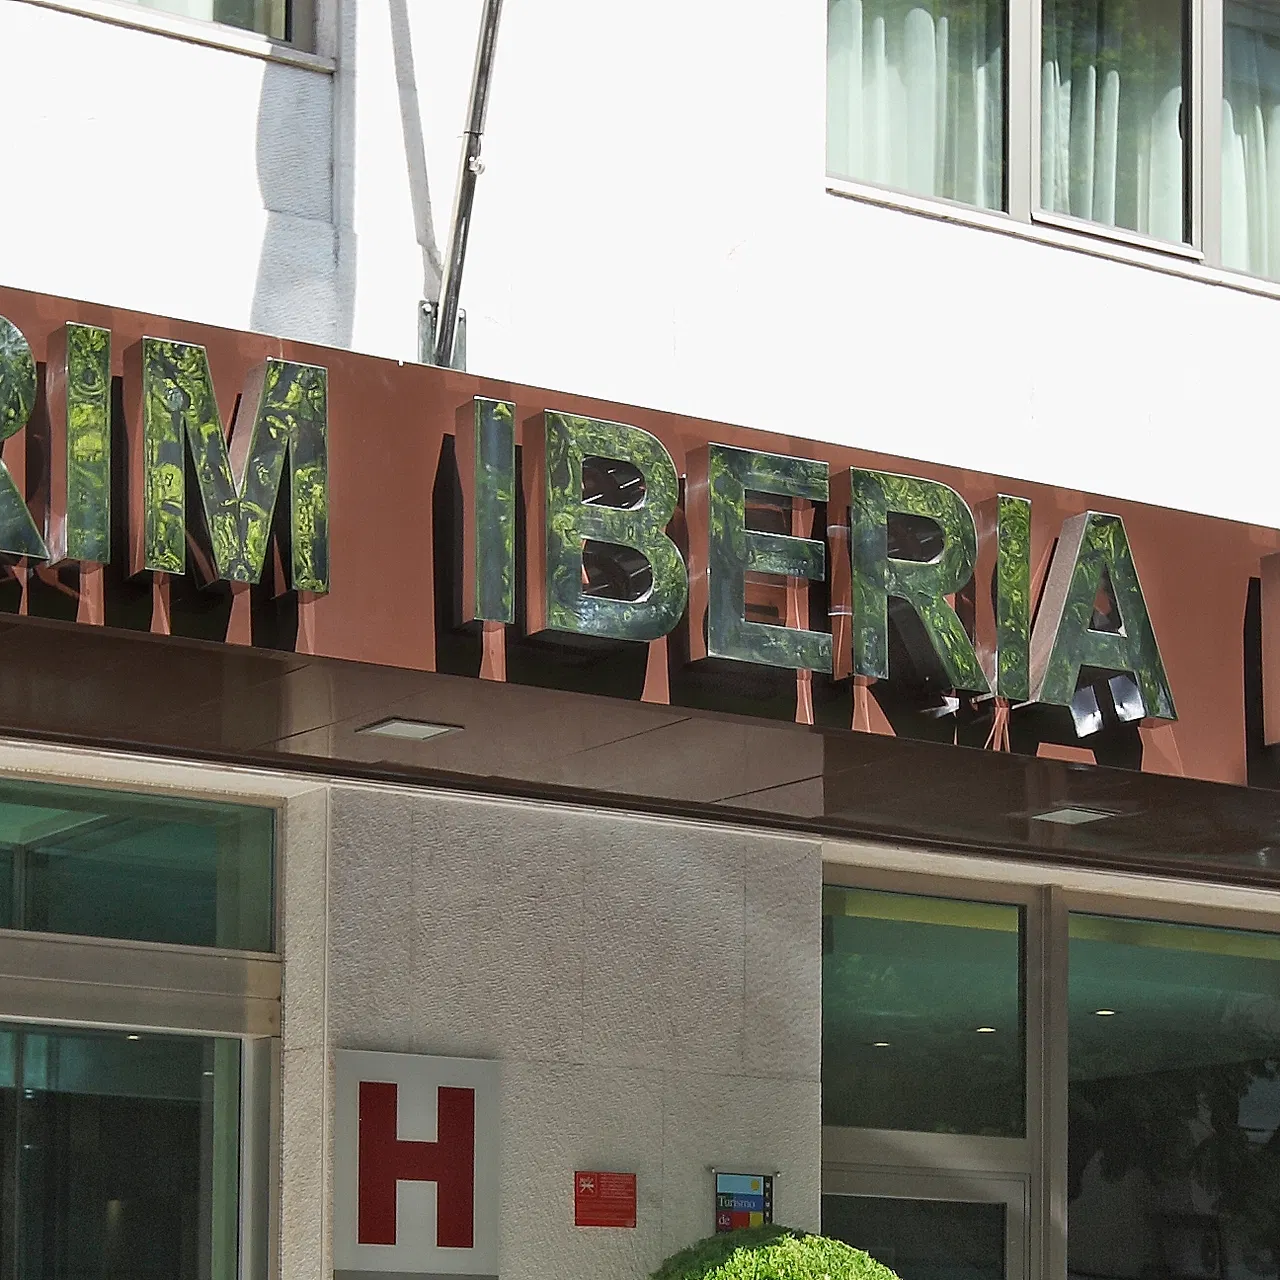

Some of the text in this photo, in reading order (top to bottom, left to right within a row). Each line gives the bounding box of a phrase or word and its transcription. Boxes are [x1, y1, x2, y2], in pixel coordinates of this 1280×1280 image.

[460, 395, 1179, 722] IBERIA
[358, 1081, 475, 1248] H
[718, 1195, 756, 1209] Turismo
[719, 1214, 730, 1225] de
